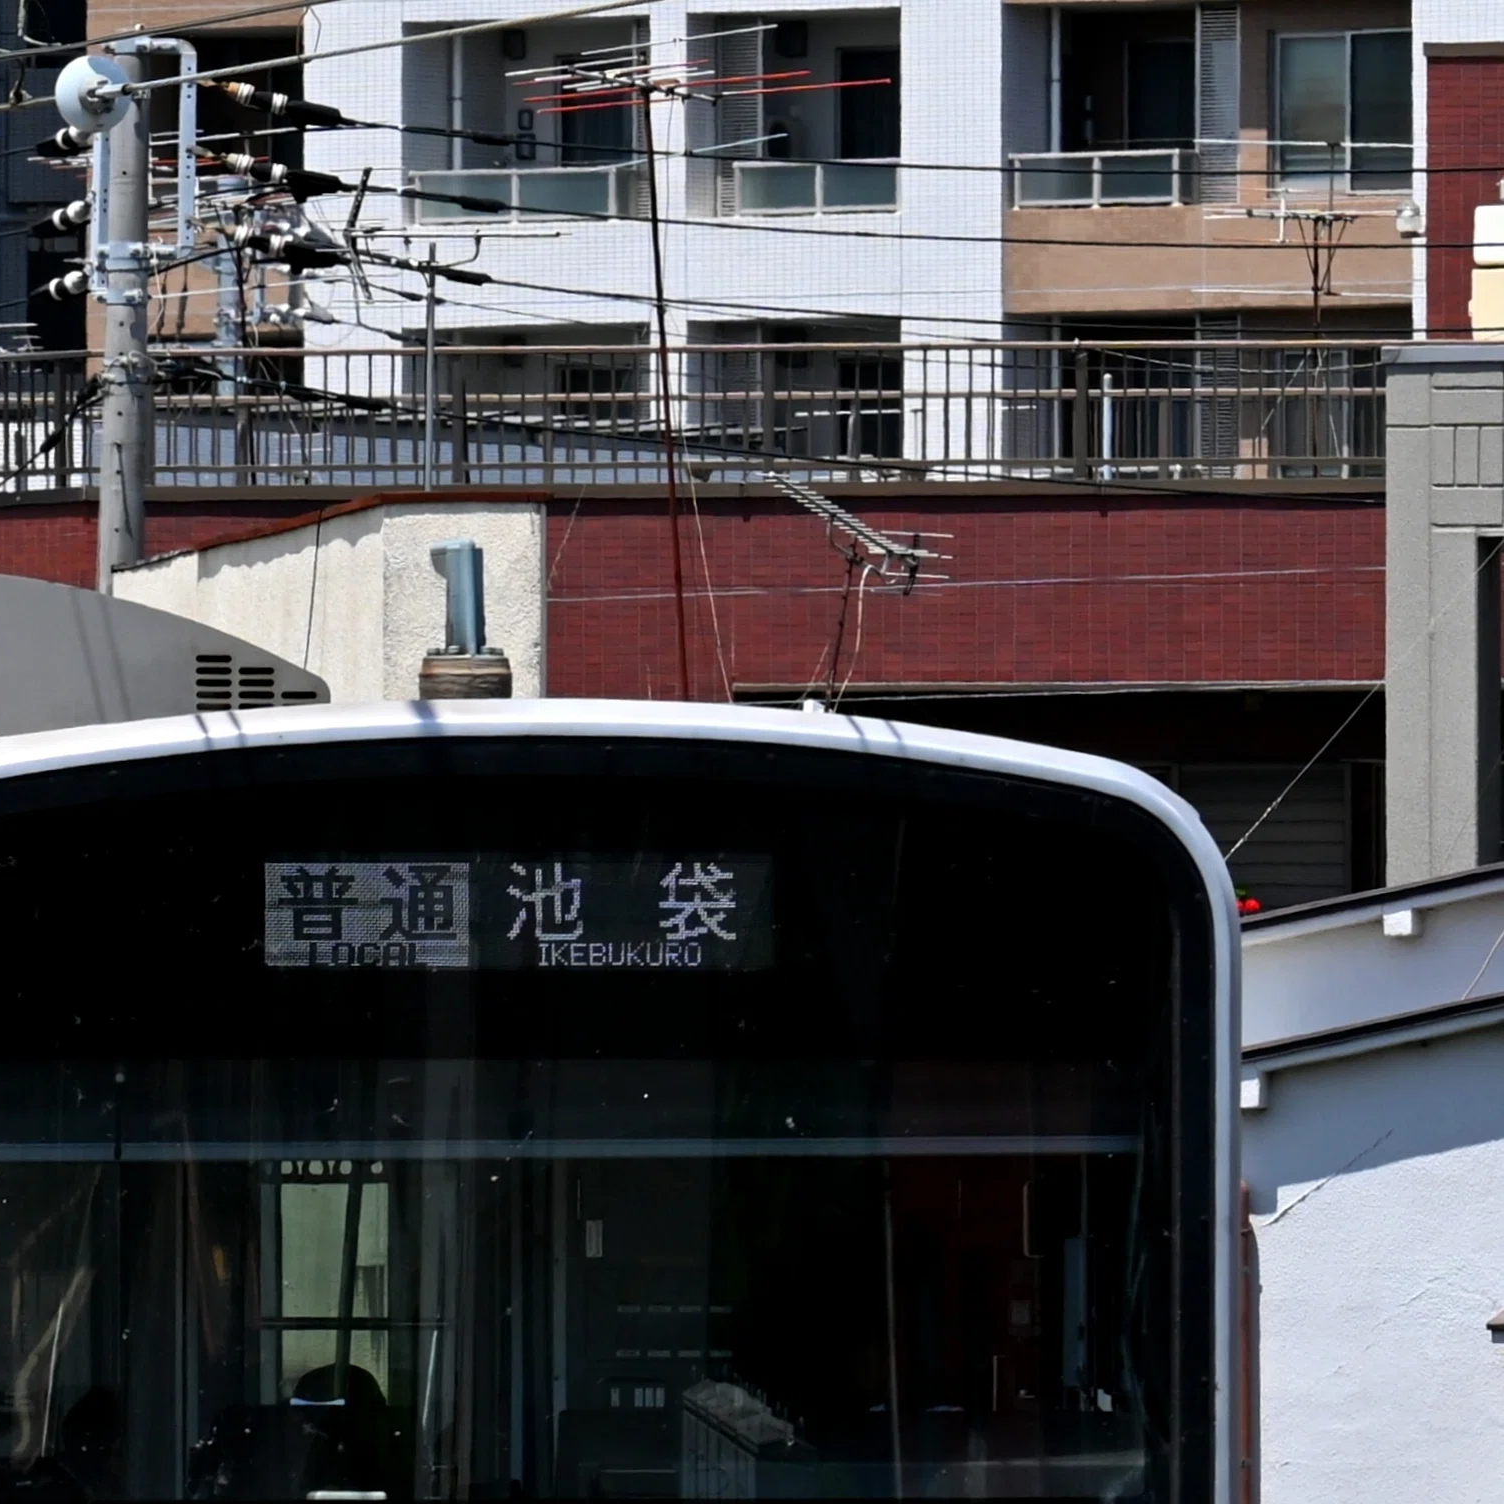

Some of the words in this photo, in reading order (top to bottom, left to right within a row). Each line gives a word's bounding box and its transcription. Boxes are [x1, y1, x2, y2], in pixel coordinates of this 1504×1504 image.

[279, 864, 459, 942] 普通
[506, 861, 738, 941] 池袋
[312, 943, 419, 966] LOCAL
[537, 942, 702, 967] IKEBUKURO
